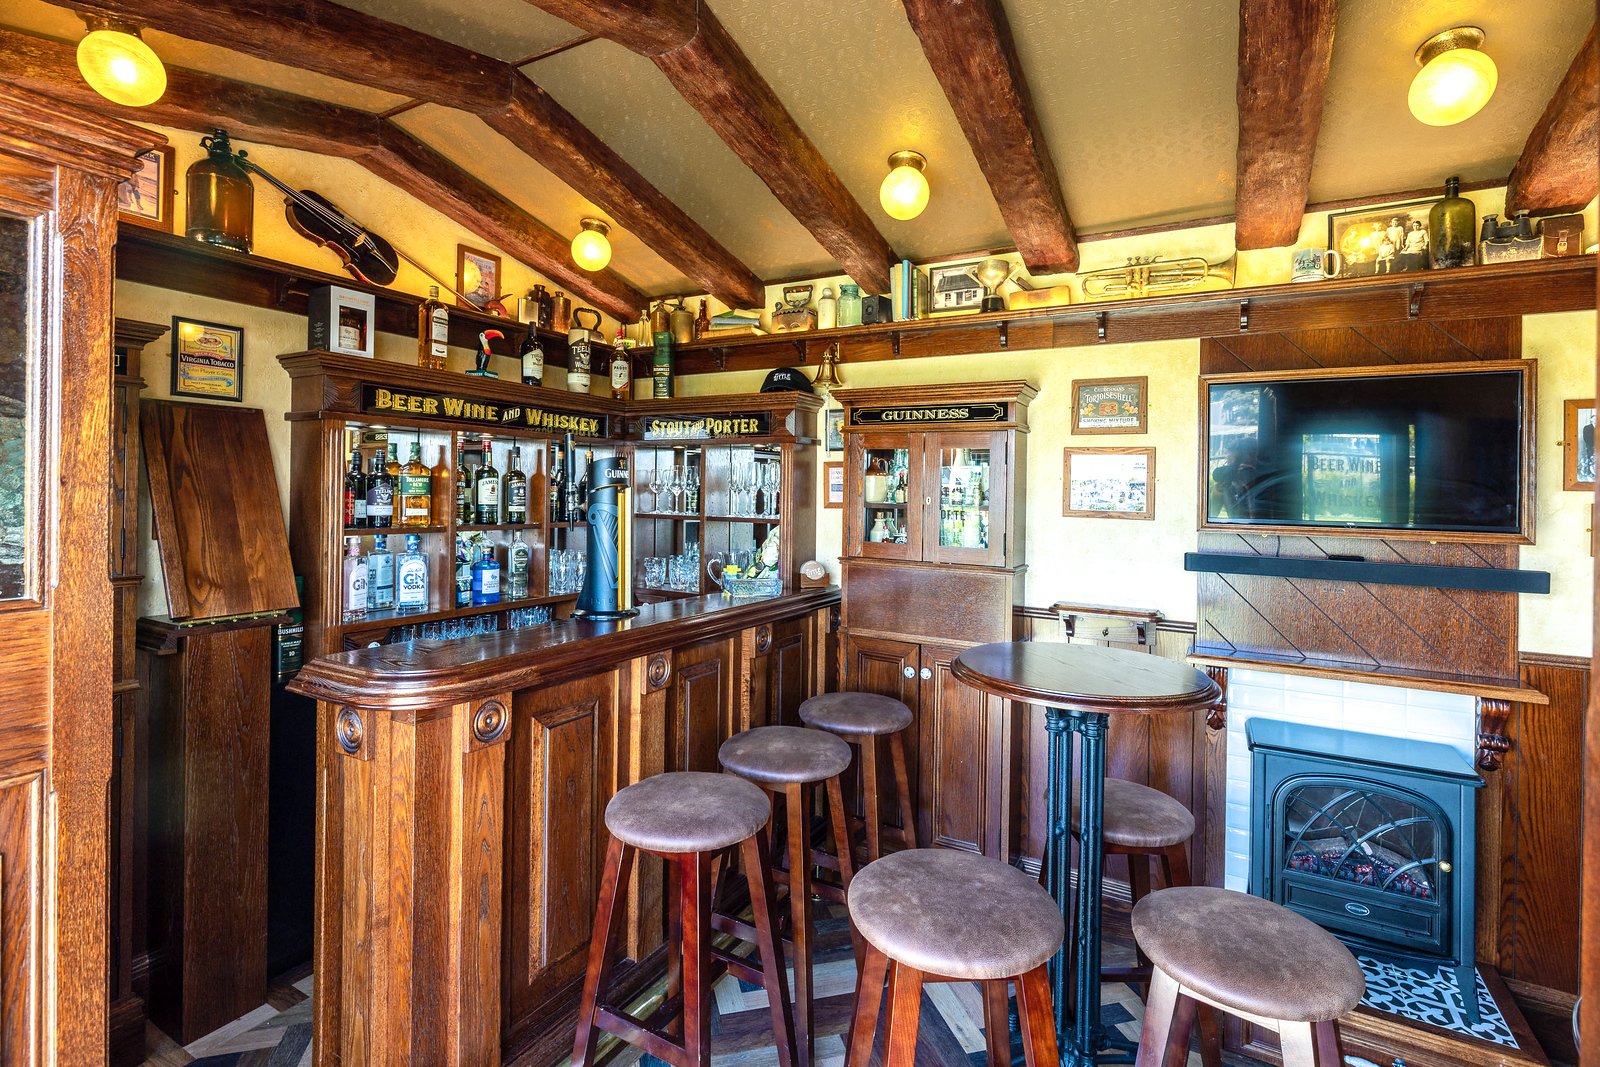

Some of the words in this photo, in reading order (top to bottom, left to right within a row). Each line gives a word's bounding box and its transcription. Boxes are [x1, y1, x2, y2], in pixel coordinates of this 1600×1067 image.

[181, 354, 210, 365] VIRGINIA
[210, 358, 235, 368] TOBACCO
[1085, 392, 1132, 404] TORTOISESHELL
[375, 388, 438, 415] BEER
[442, 397, 499, 421] WINE
[502, 406, 521, 422] AND
[525, 408, 599, 431] WHISKEY
[881, 408, 969, 421] GUINNESS
[650, 419, 692, 436] STOUT
[705, 417, 759, 434] PORTER
